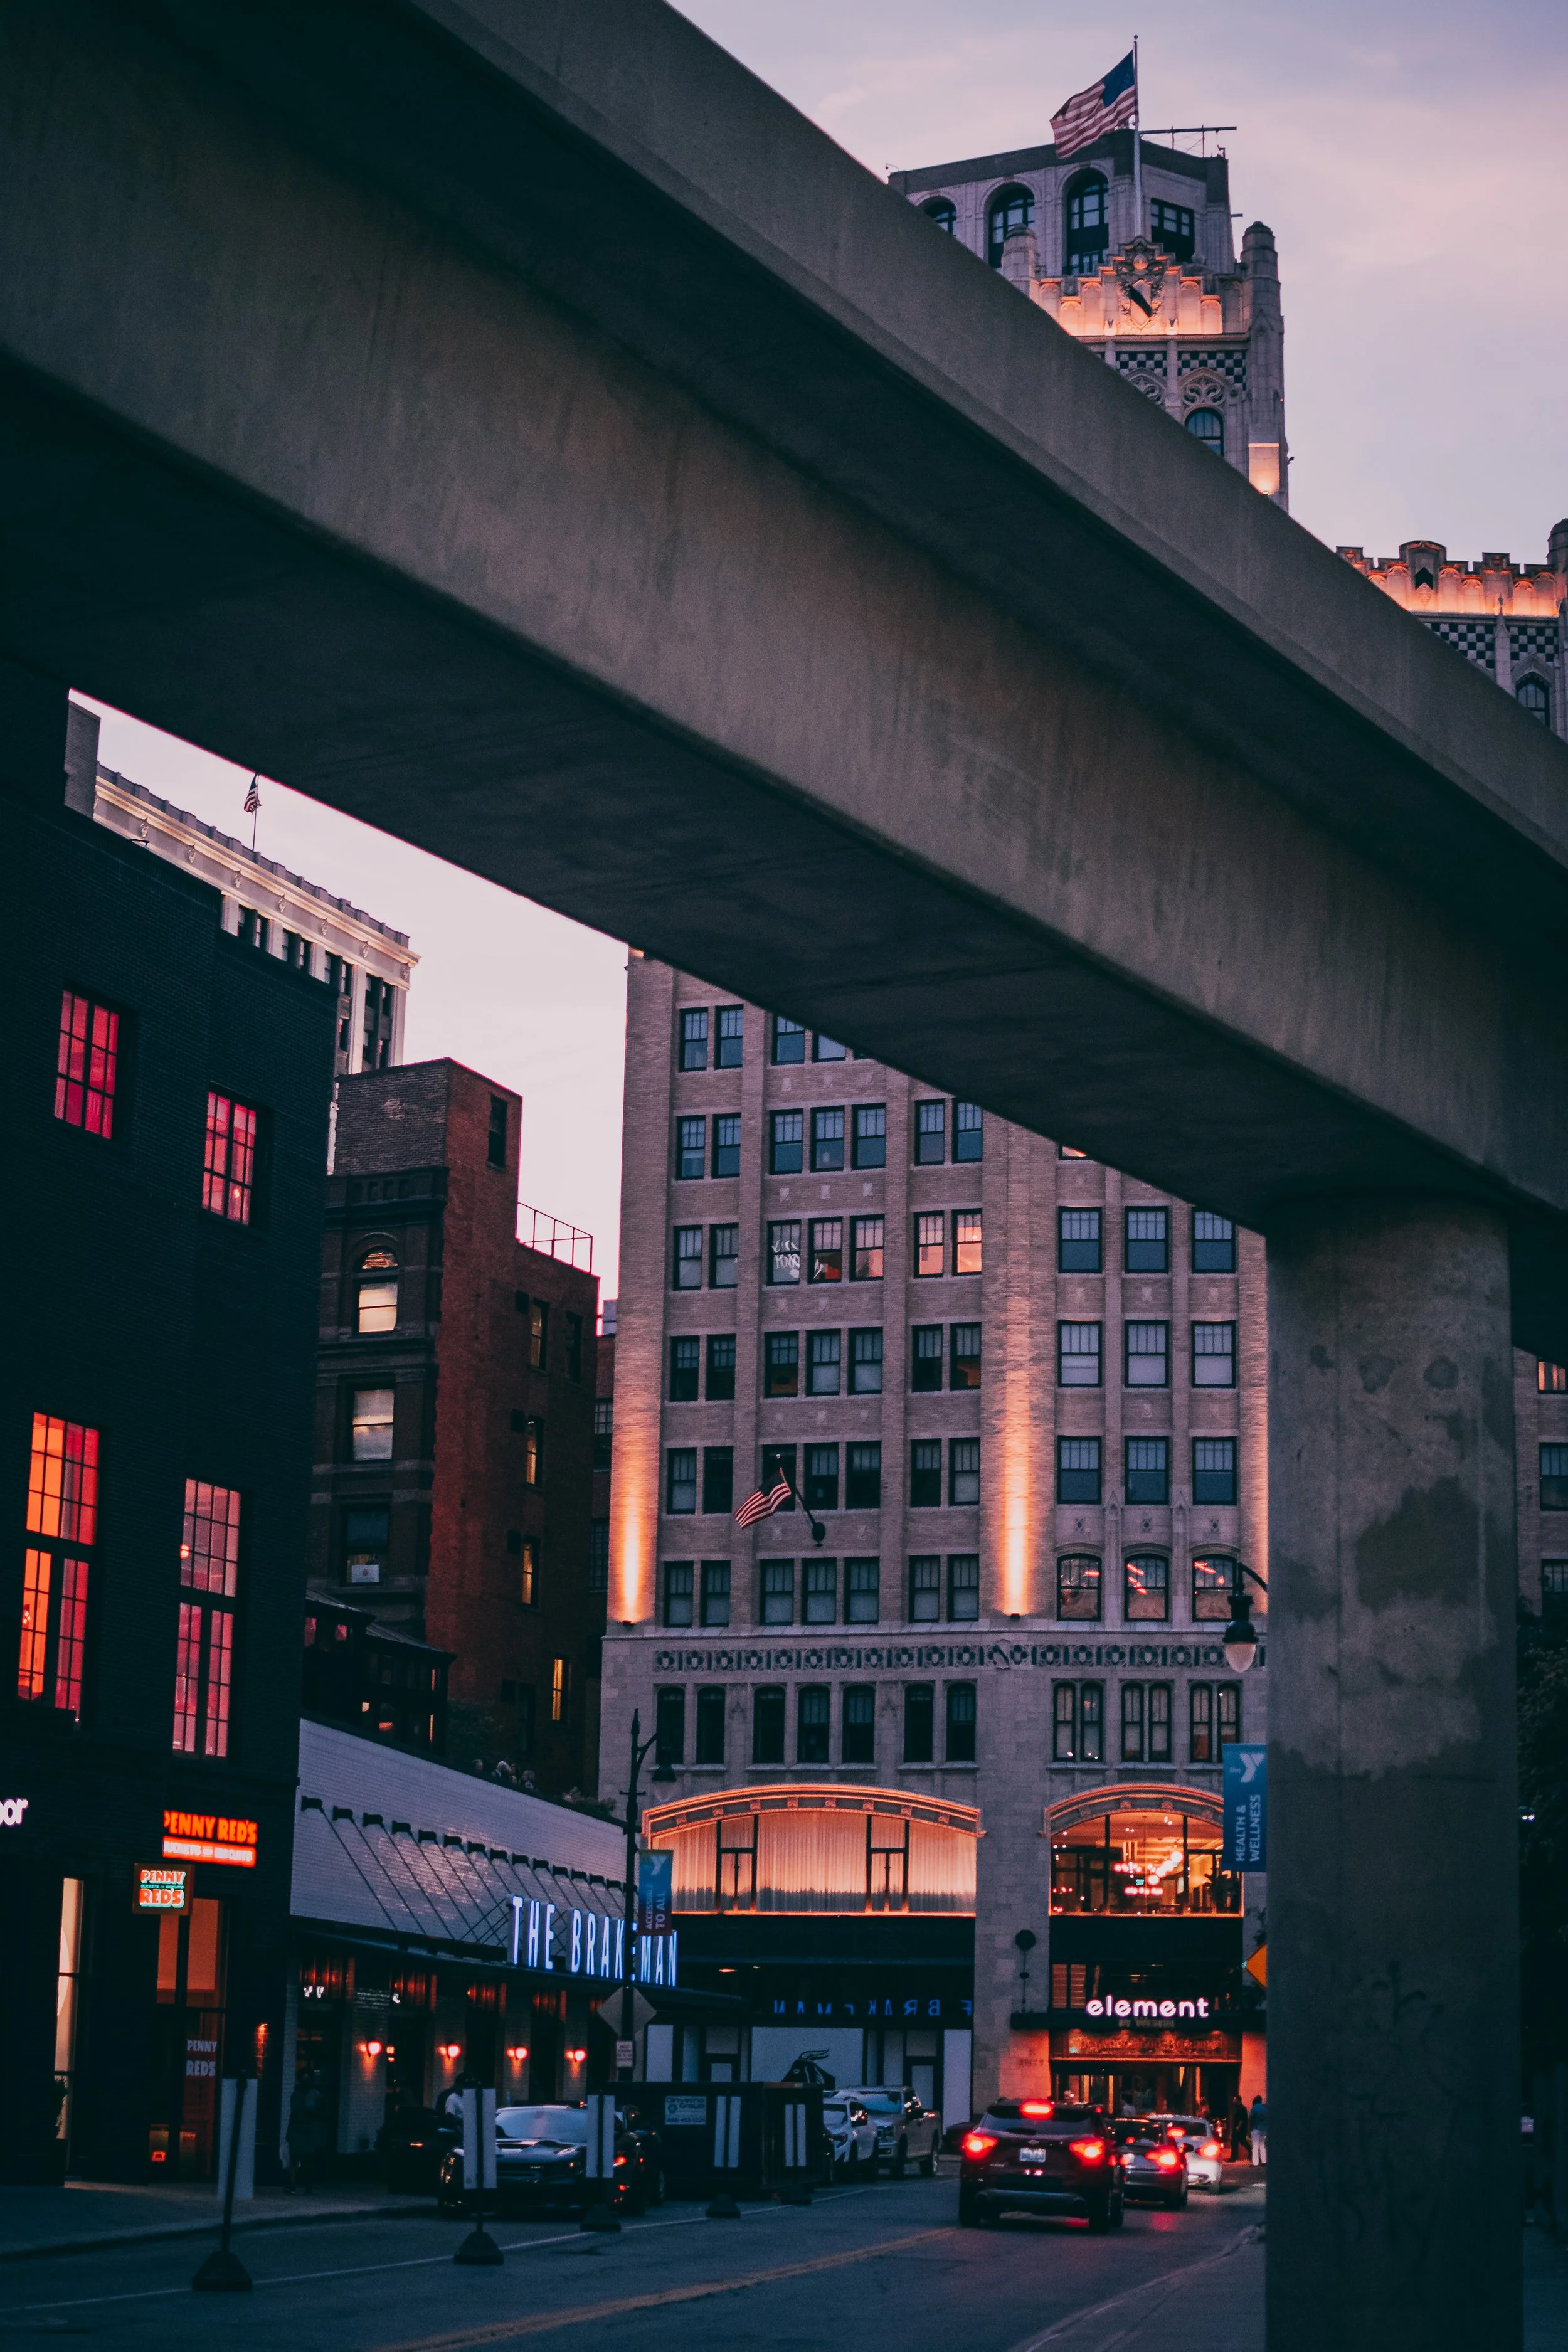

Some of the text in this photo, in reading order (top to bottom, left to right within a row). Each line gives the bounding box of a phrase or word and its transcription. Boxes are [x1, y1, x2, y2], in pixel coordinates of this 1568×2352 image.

[0, 1798, 29, 1826] or
[217, 1817, 258, 1845] RED'S
[1236, 1804, 1247, 1862] HEALTH &
[1249, 1794, 1261, 1862] WELLNESS
[140, 1870, 186, 1885] PENNY
[139, 1888, 184, 1908] RED'S
[645, 1883, 654, 1930] ACCESSIBLE
[655, 1890, 665, 1929] TO ALL
[512, 1895, 557, 1970] THE
[1086, 1994, 1210, 2018] element
[187, 2040, 217, 2052] PENNY
